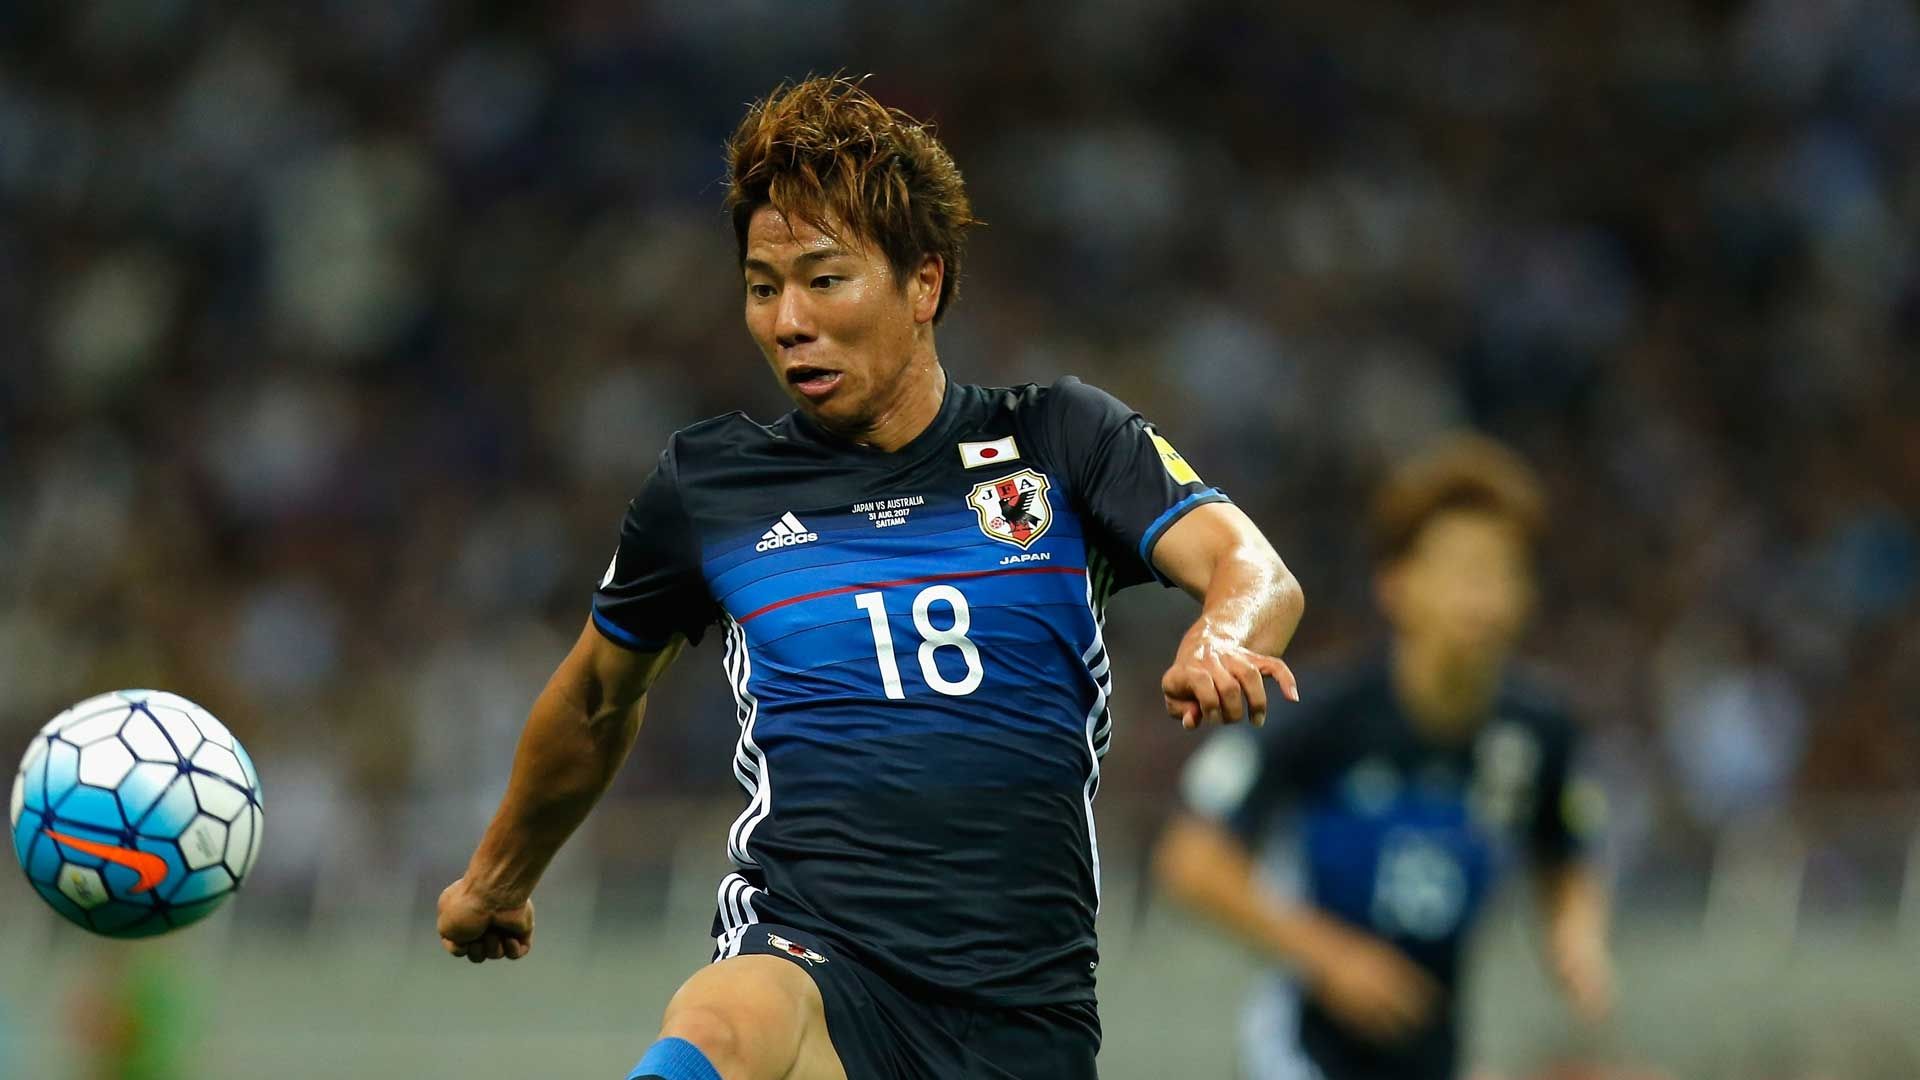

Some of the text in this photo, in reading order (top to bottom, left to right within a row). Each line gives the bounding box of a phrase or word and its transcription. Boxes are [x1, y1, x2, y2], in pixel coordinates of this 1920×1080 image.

[852, 495, 924, 513] JAPAN VS AUSTRALIA
[868, 512, 876, 520] 31
[894, 508, 910, 517] 2017
[875, 517, 905, 528] SAITAMA
[755, 532, 818, 552] adidas
[1000, 552, 1050, 565] JAPAN
[855, 584, 984, 700] 18
